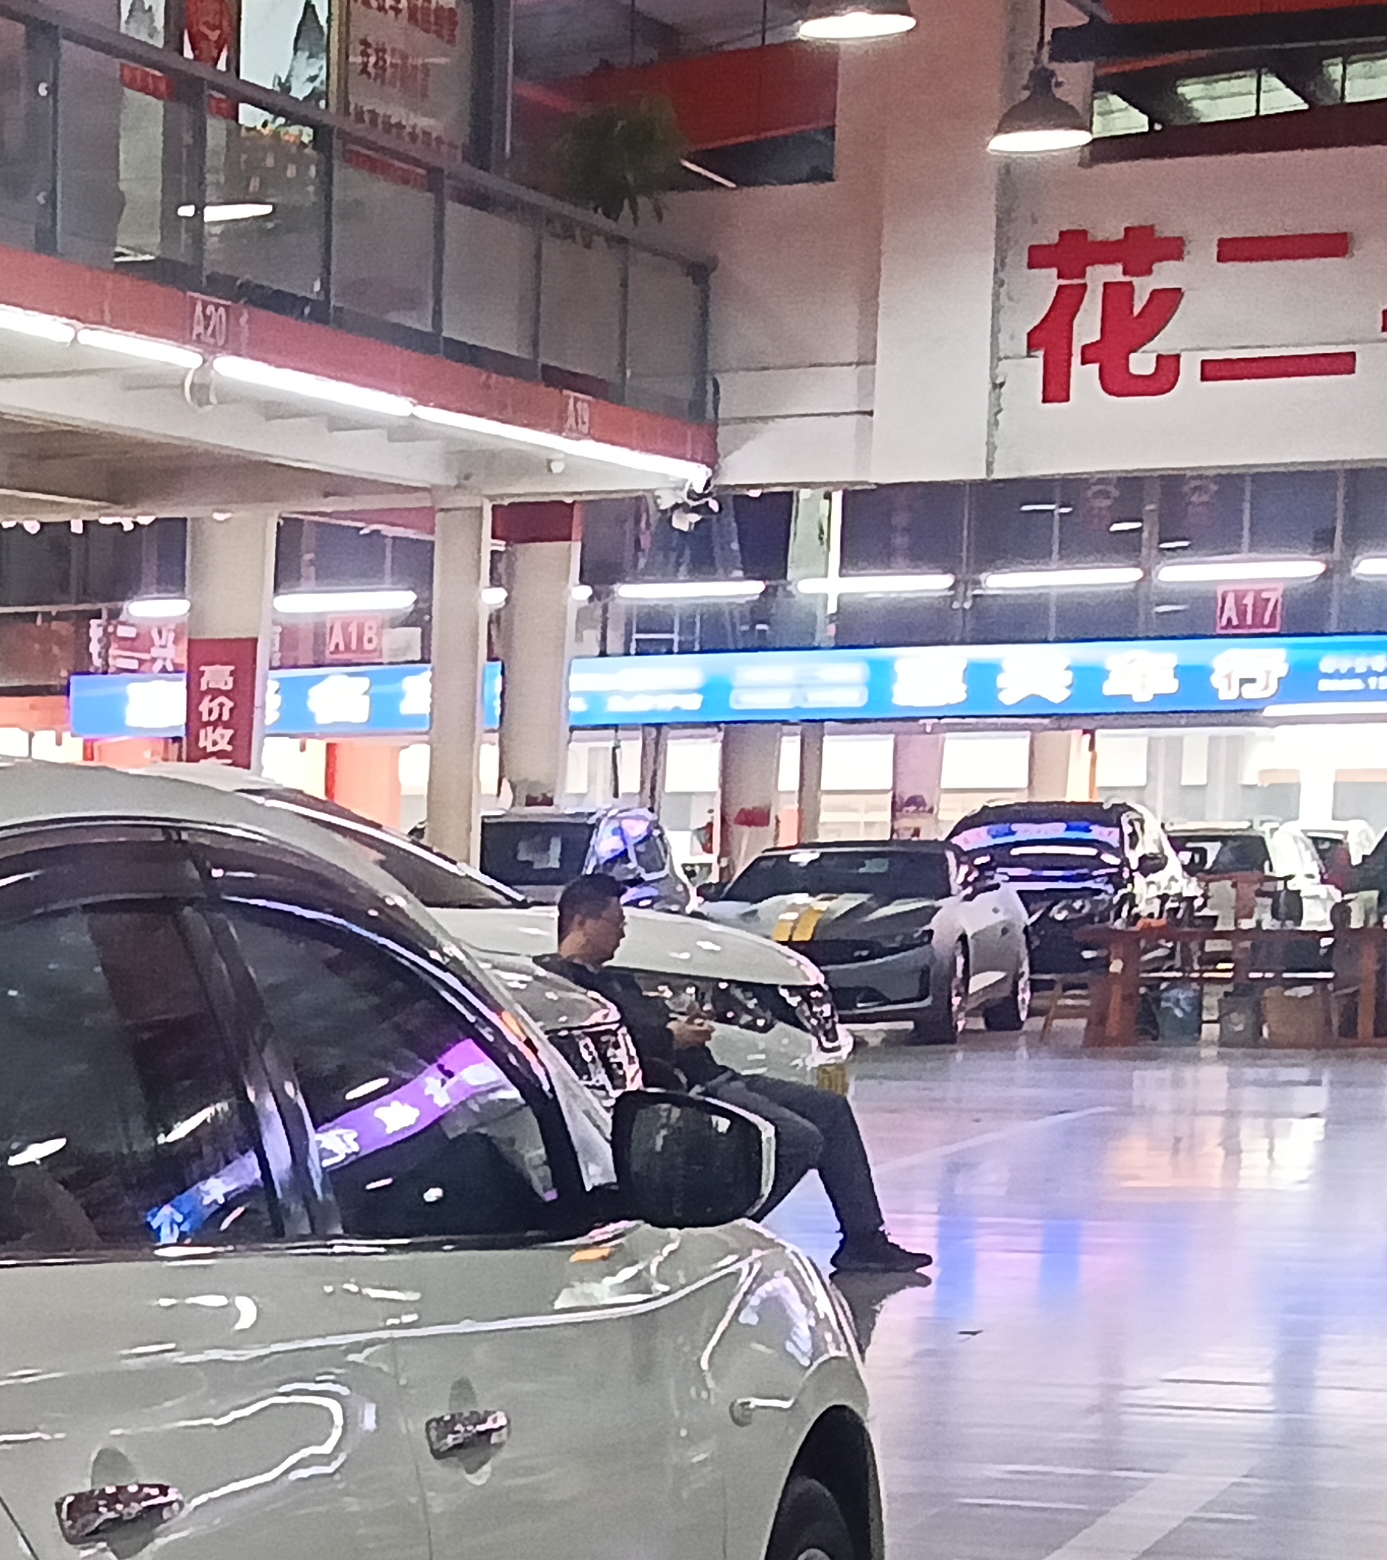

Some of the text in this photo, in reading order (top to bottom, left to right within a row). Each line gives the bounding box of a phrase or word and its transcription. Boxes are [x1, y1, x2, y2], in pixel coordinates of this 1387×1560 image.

[191, 298, 227, 347] A20
[1026, 224, 1387, 405] 花二
[1220, 590, 1281, 627] A17
[328, 619, 378, 652] A18
[197, 664, 236, 764] 高价收
